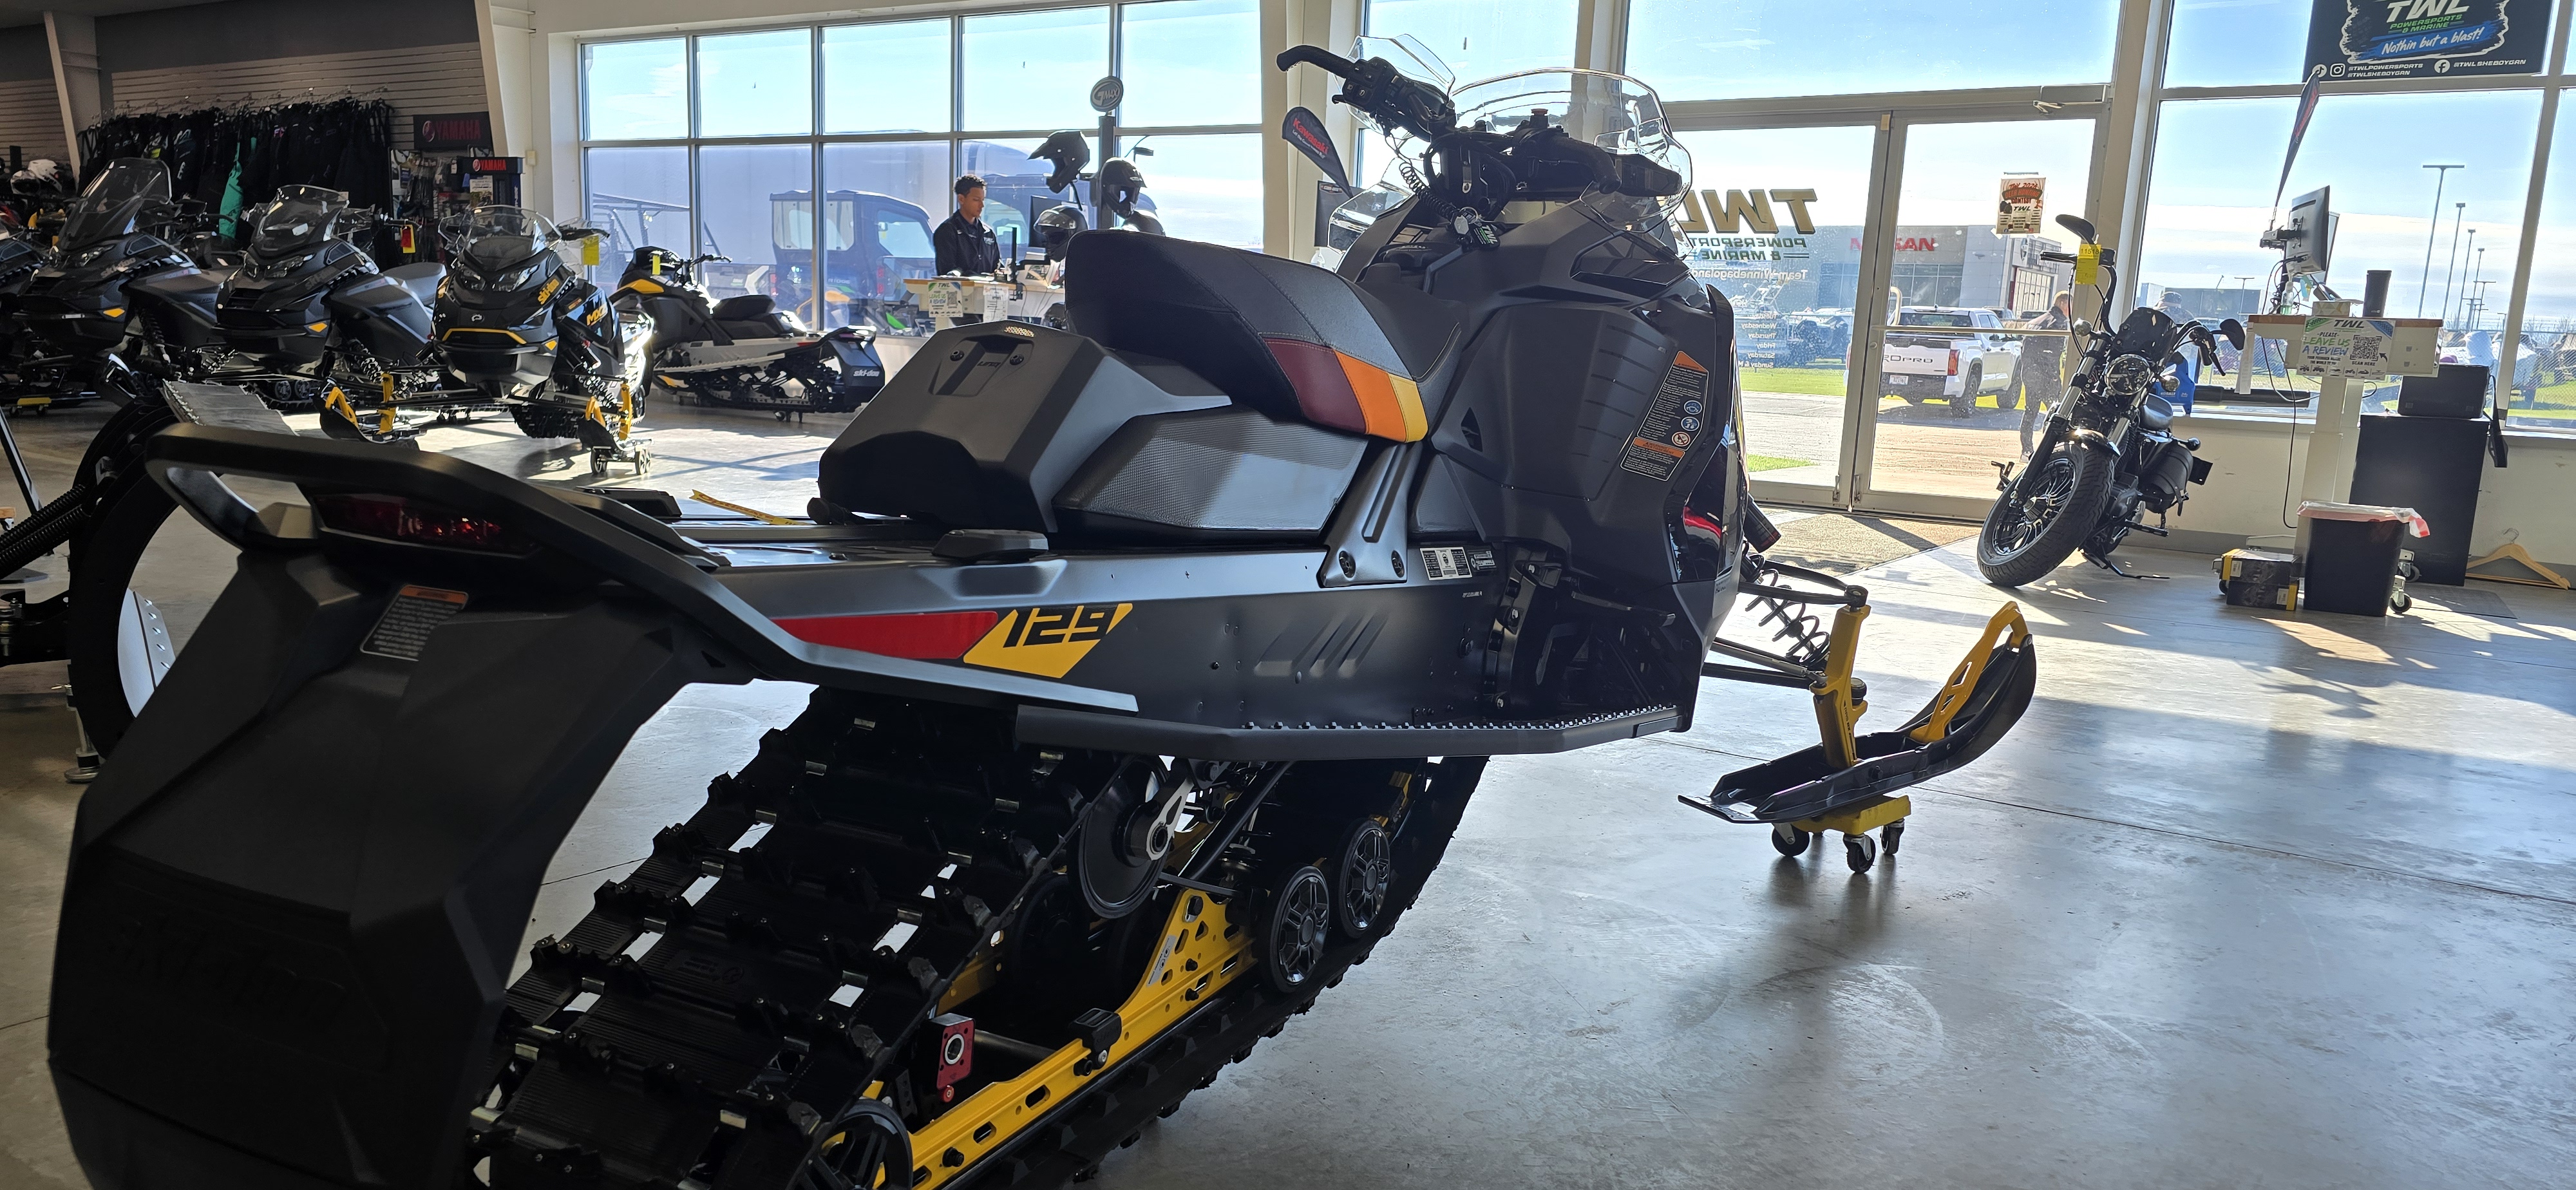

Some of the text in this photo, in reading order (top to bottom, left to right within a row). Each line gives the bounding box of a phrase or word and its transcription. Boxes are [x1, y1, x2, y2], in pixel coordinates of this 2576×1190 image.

[2387, 0, 2470, 23] TWL
[2390, 14, 2463, 30] POWERSPORTS
[2410, 22, 2450, 32] MARINE
[2382, 41, 2417, 55] Nothin
[2419, 34, 2439, 49] but
[2450, 26, 2485, 43] blast!
[2348, 63, 2423, 71] @TWLPOWERSPORTS
[435, 120, 482, 140] YAMAHA
[1293, 117, 1329, 155] Kawasaki
[480, 159, 506, 171] YAMAHA
[2005, 189, 2017, 198] DEER
[1482, 225, 1498, 245] TWL
[2334, 319, 2365, 328] TWL
[2337, 338, 2351, 347] US
[2302, 345, 2349, 356] A REVIEW
[1003, 605, 1119, 648] 129
